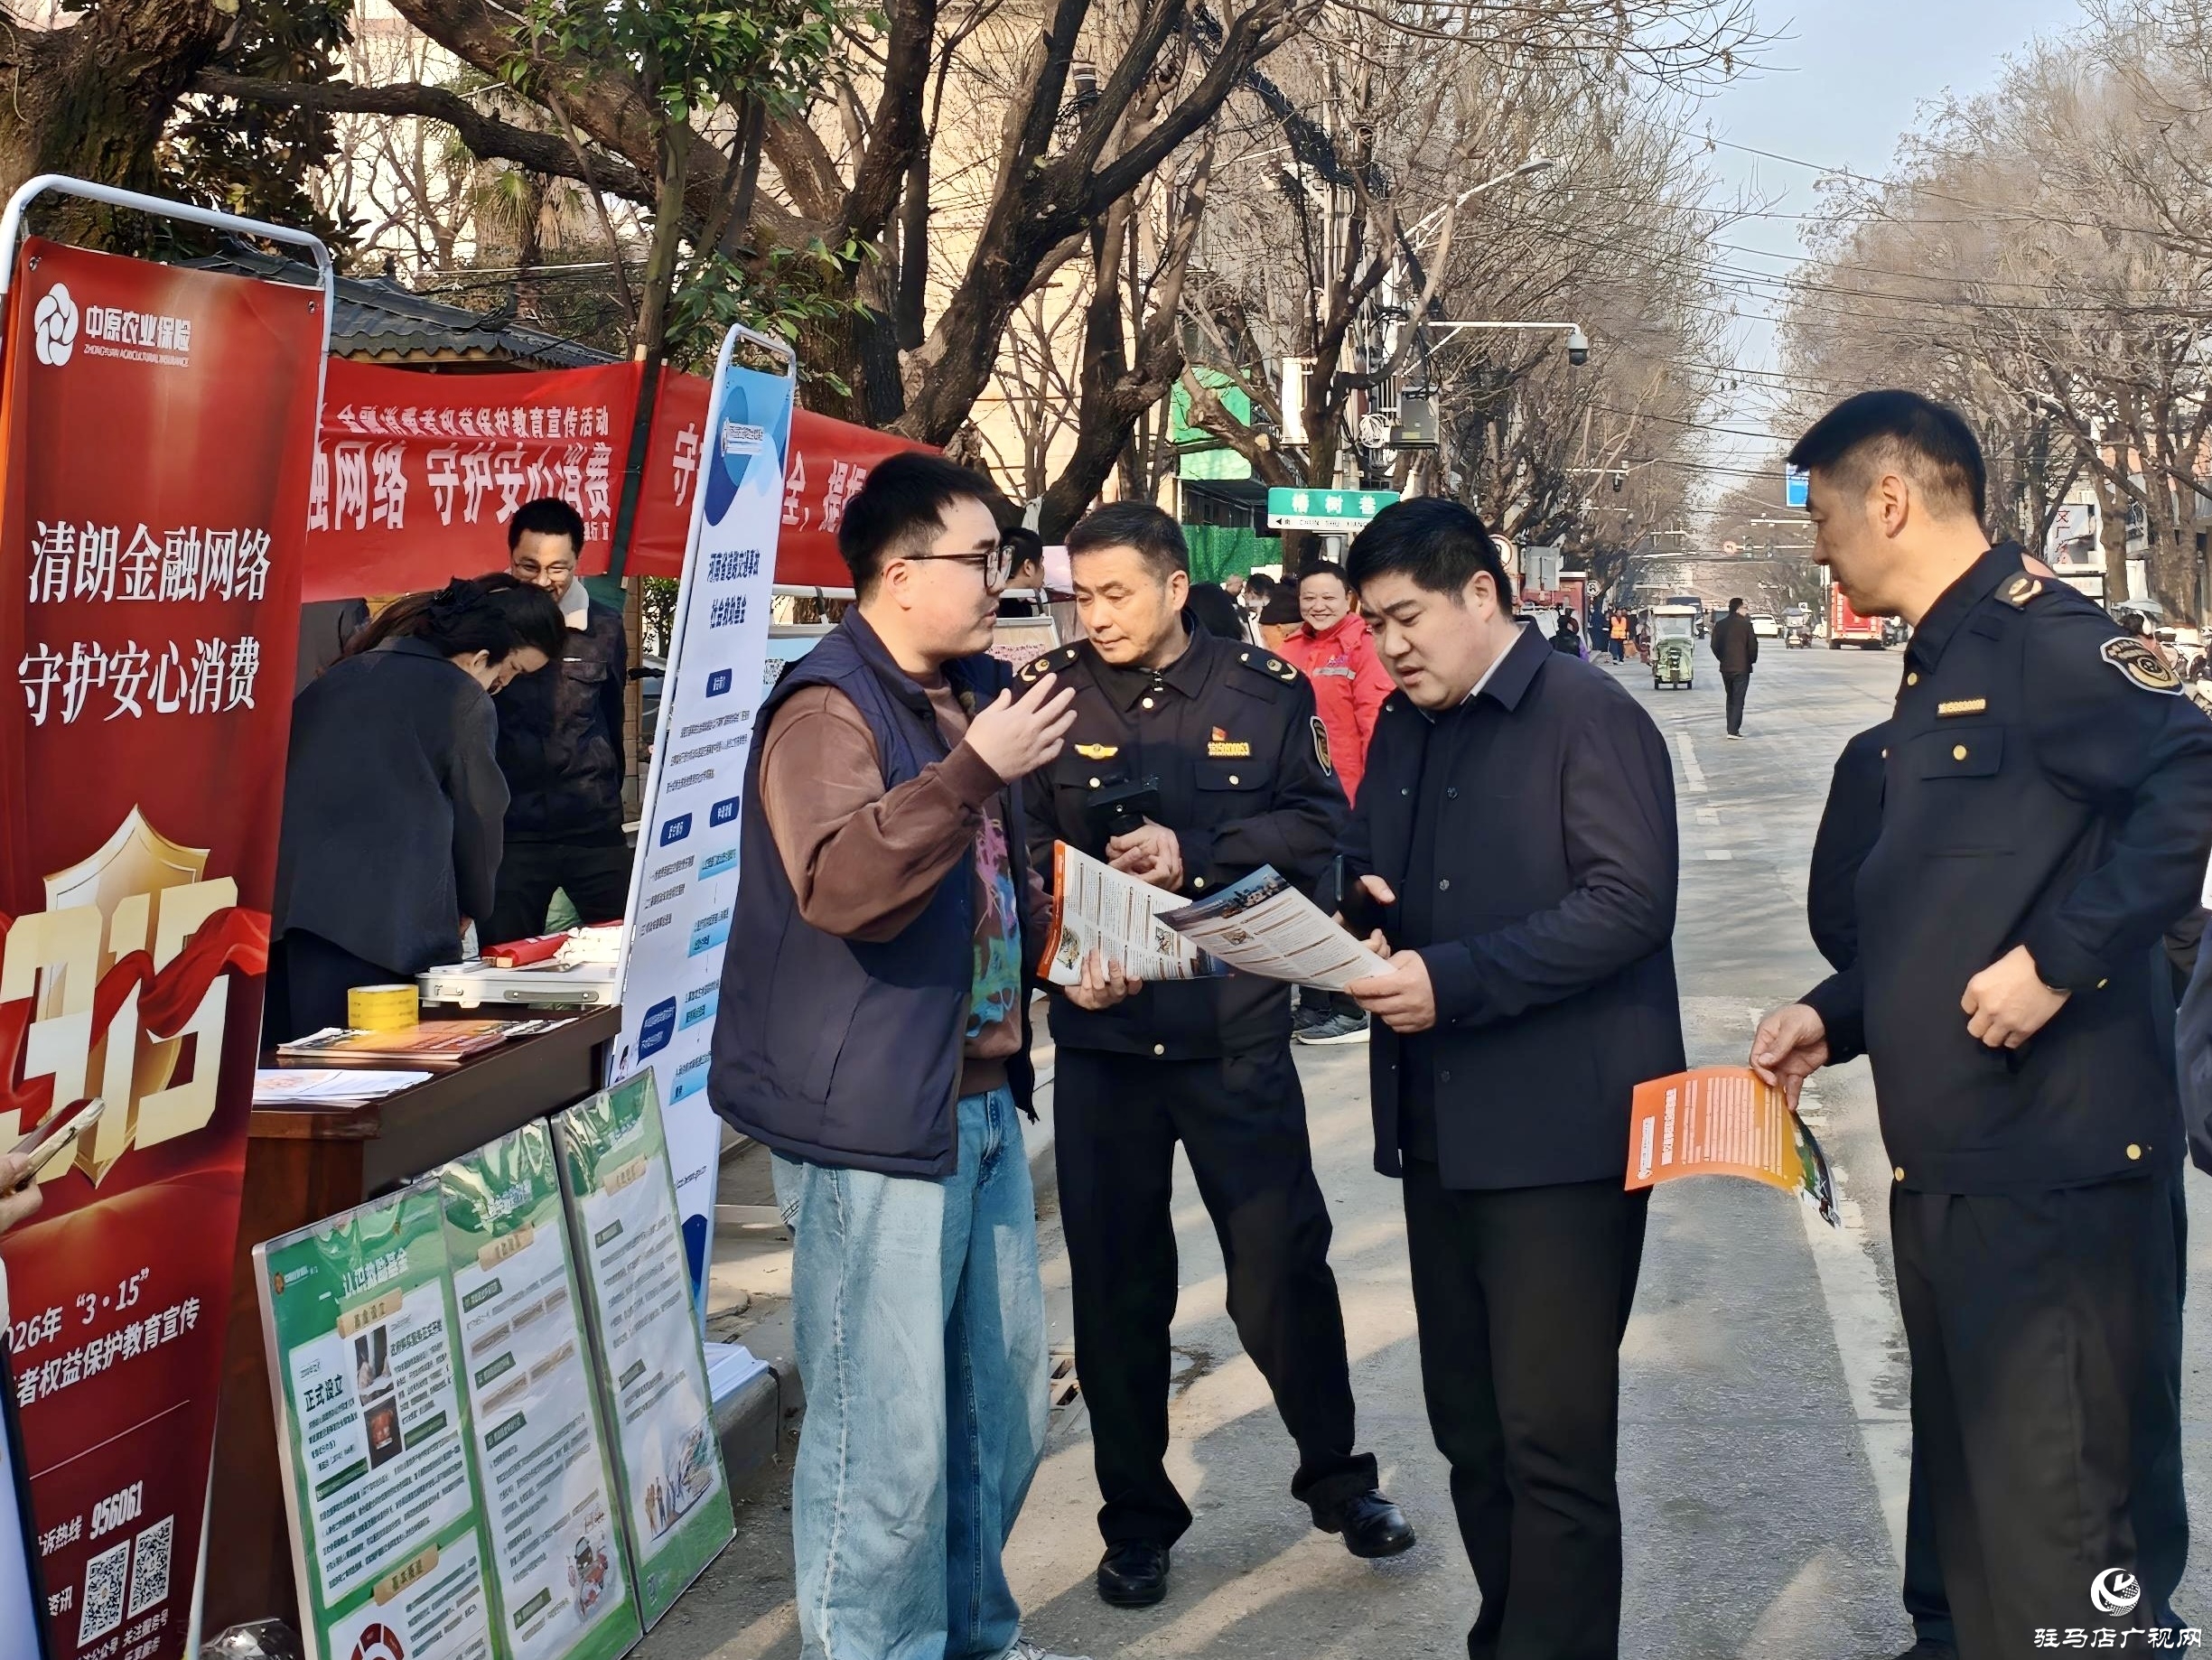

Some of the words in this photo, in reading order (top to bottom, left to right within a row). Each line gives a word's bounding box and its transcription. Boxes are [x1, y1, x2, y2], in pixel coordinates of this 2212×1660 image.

[85, 305, 191, 352] 中原农业保险
[319, 403, 609, 438] 金融消费者权益保护教育宣传活动
[426, 441, 612, 527] 守护安心消费
[673, 423, 705, 508] 守
[29, 520, 272, 603] 清朗金融网络
[18, 636, 260, 727] 守护安心消费
[14, 1297, 201, 1408] 者权益保护教育宣传
[39, 1515, 83, 1557] 诉热线
[89, 1480, 144, 1540] 956061
